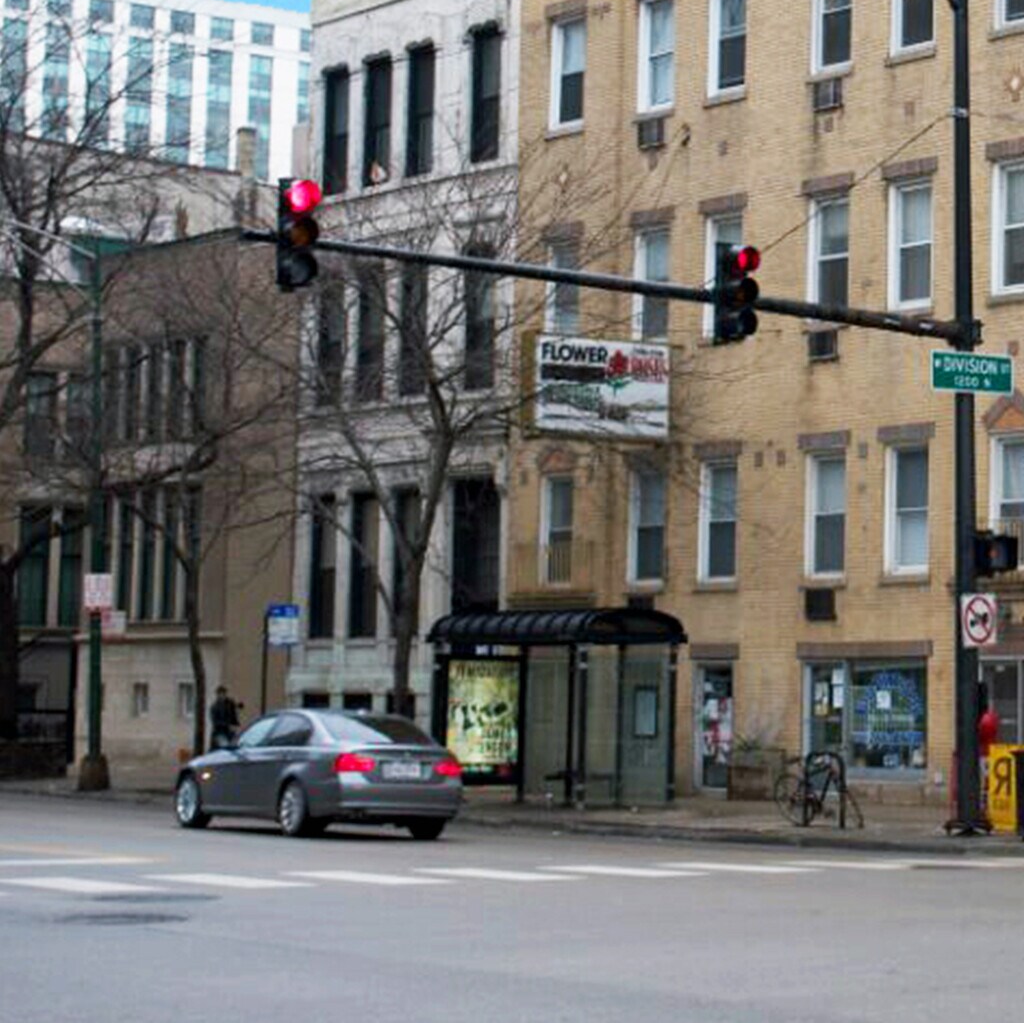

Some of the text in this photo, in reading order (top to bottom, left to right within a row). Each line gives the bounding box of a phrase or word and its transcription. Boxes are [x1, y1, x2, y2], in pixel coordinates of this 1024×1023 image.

[541, 342, 608, 364] FLOWER
[943, 357, 998, 375] DIVISION
[954, 375, 980, 387] 1200
